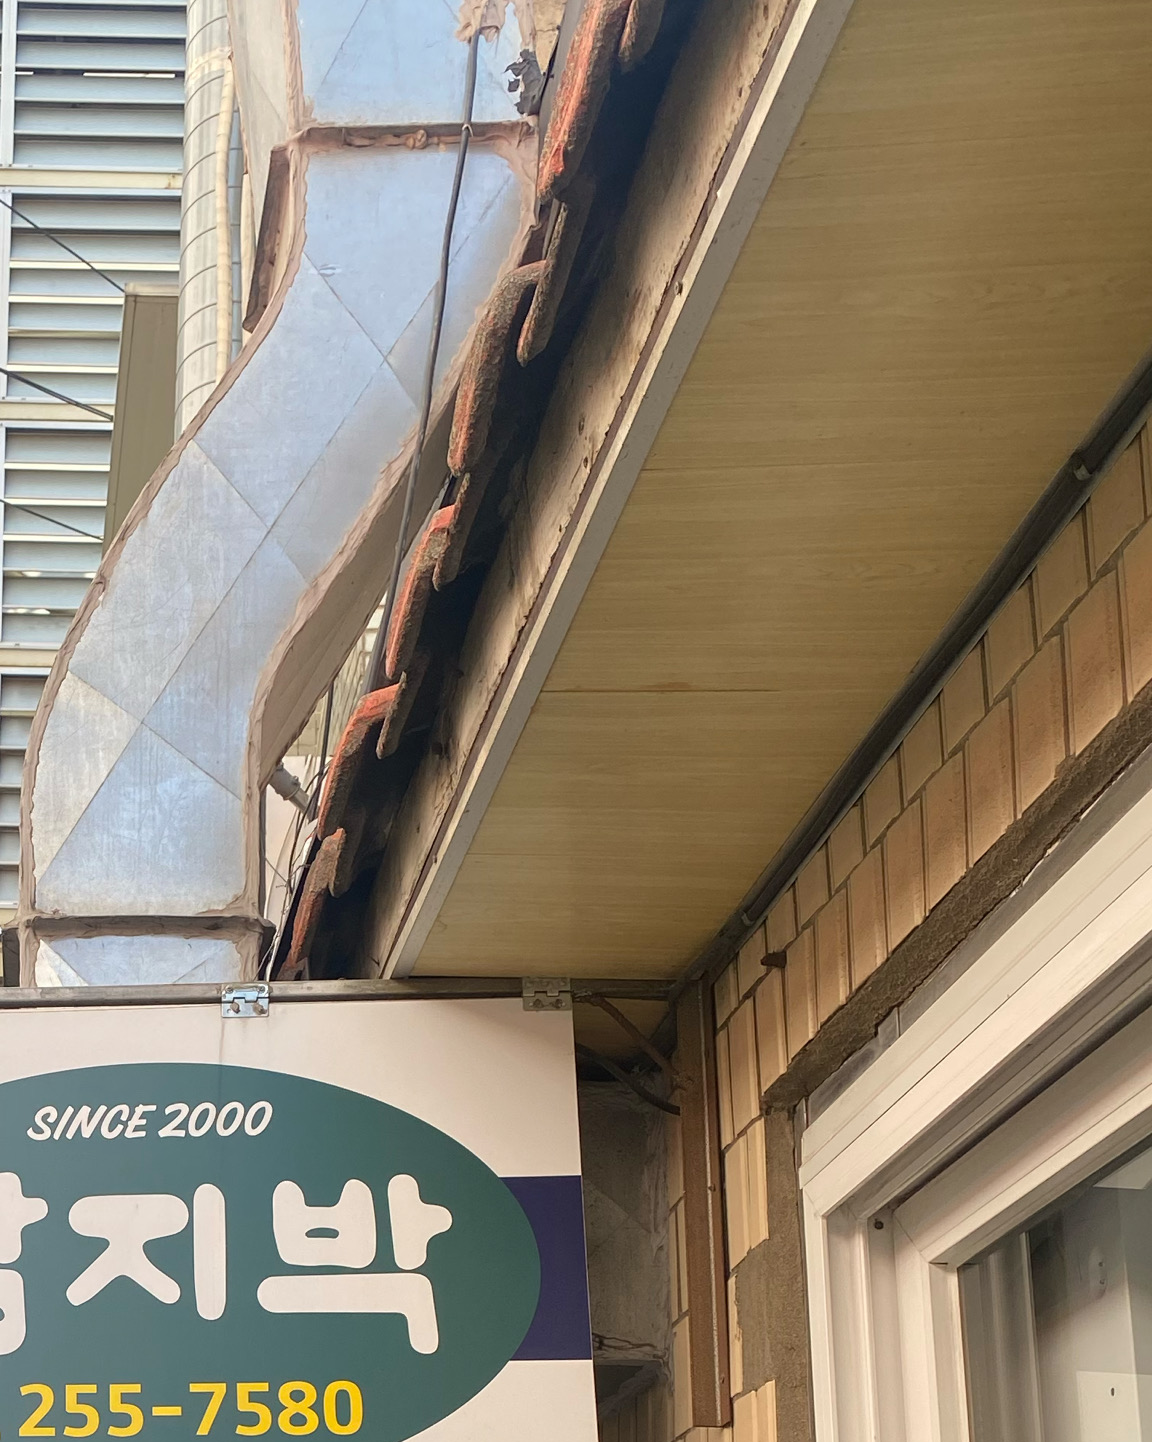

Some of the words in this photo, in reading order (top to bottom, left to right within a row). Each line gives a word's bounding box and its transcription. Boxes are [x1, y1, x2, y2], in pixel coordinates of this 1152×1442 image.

[26, 1104, 157, 1141] SINCE
[159, 1100, 273, 1137] 2000
[18, 1380, 364, 1438] 255-7580
